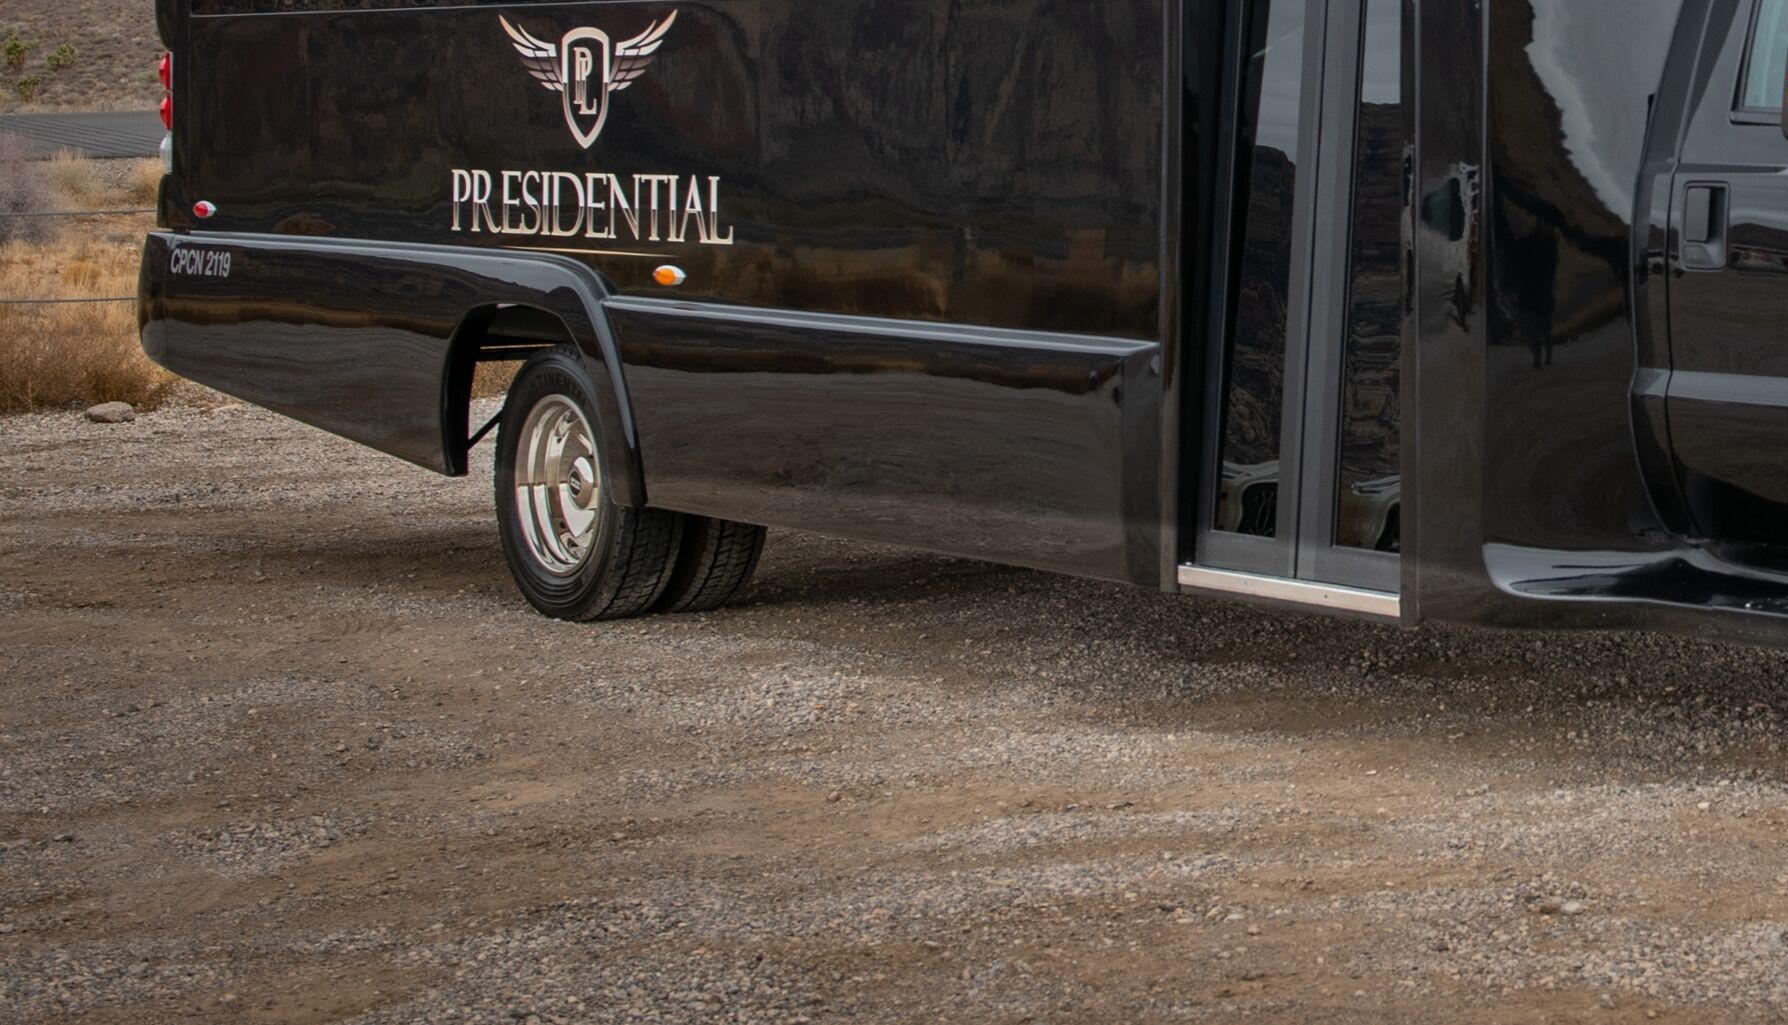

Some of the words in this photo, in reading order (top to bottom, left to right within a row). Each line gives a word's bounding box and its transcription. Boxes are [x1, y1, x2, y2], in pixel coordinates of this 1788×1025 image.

[450, 168, 734, 245] PRESIDENTIAL
[170, 247, 205, 275] CPCN
[205, 250, 232, 278] 2119
